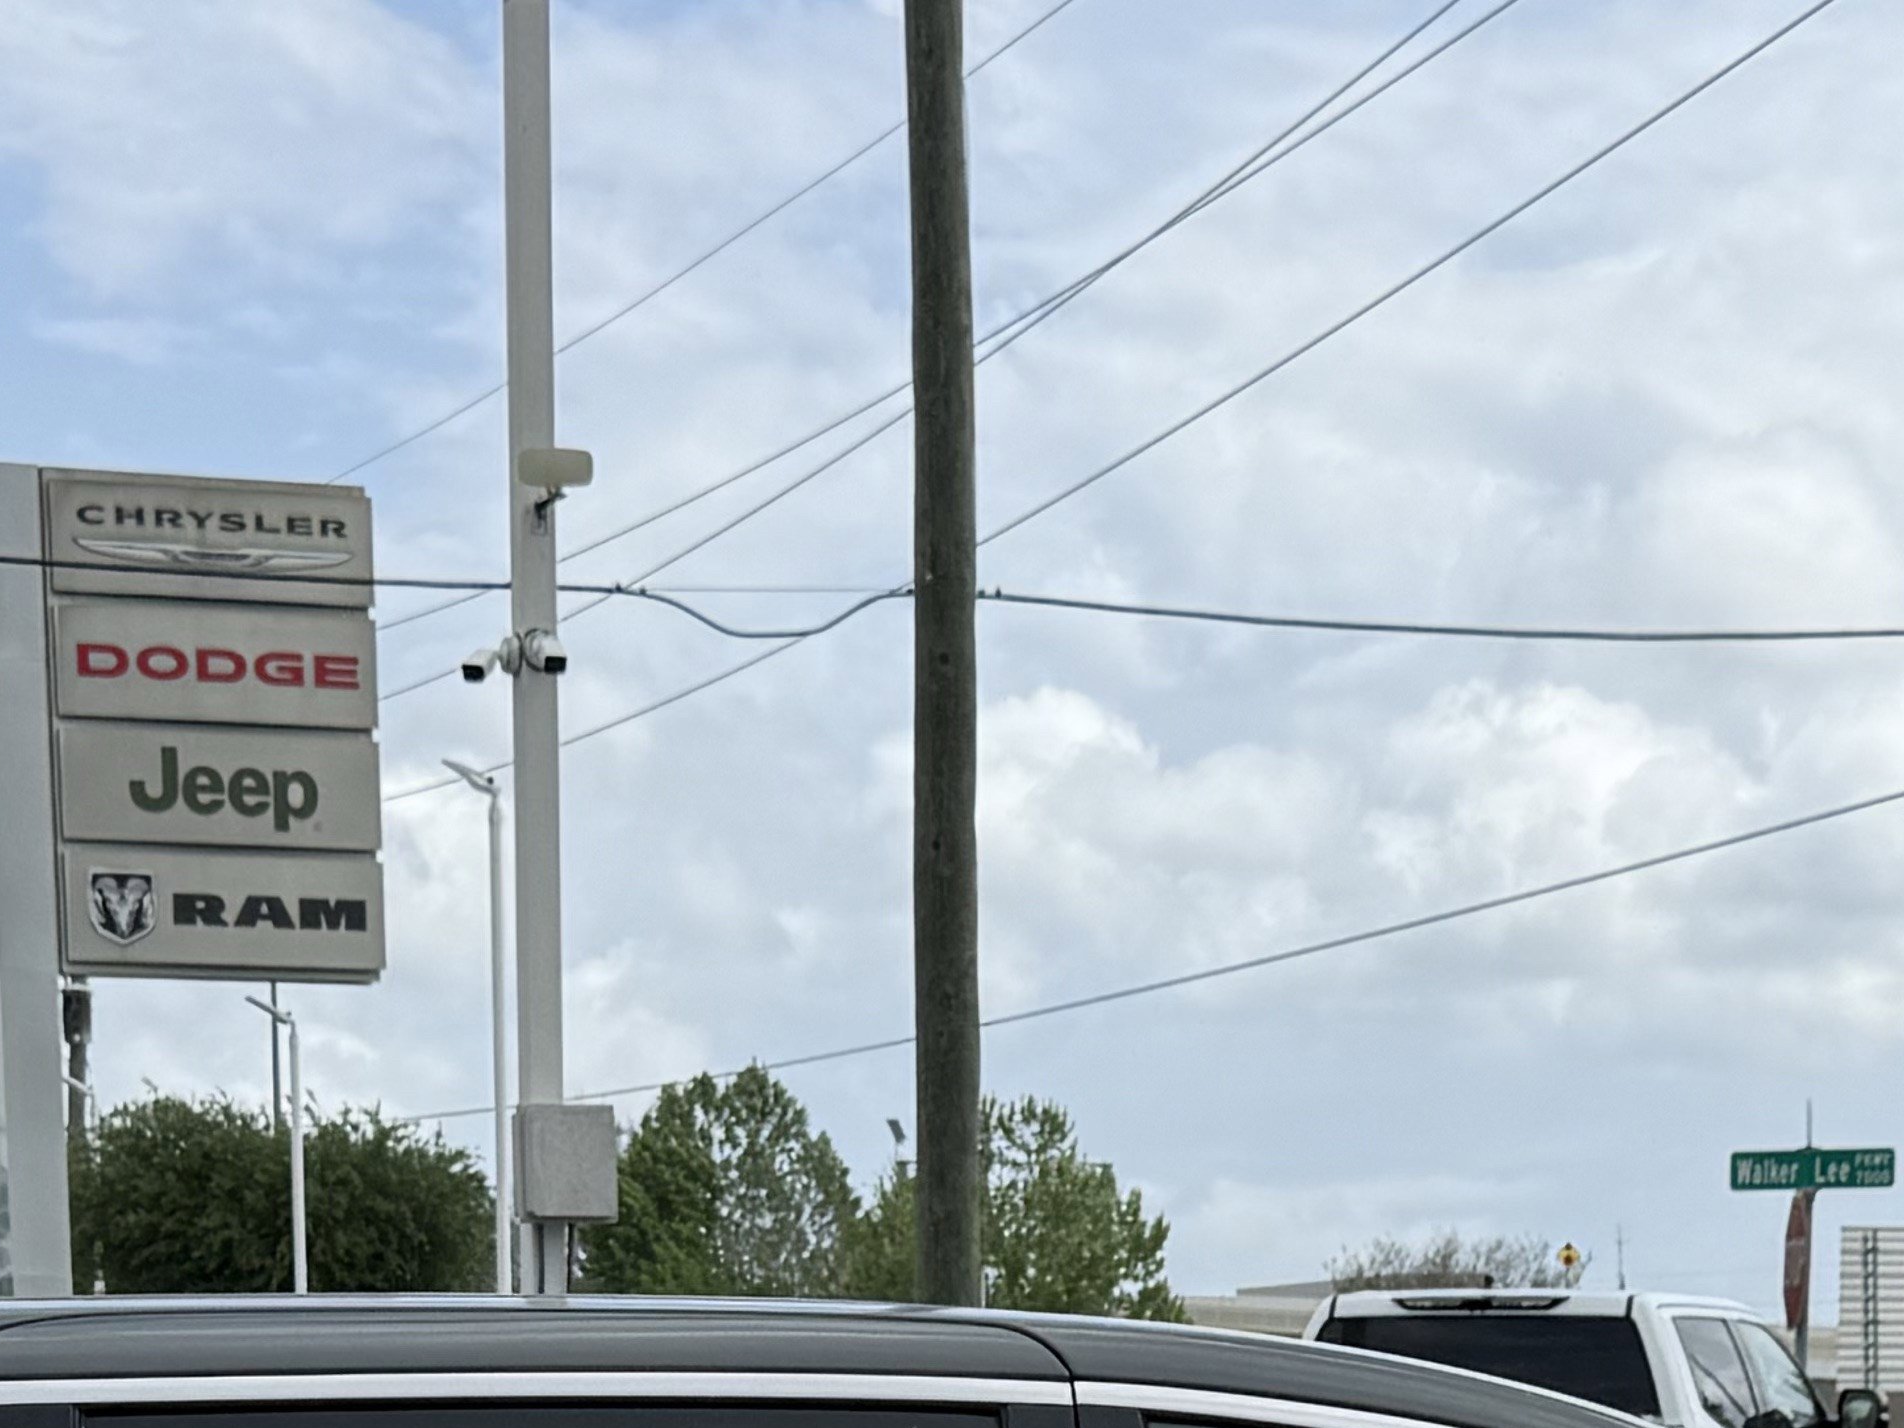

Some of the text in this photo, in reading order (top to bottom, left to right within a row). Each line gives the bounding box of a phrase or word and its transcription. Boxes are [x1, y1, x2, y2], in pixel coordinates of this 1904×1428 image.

[75, 504, 348, 538] CHRYSLER
[76, 643, 360, 690] DODGE
[129, 746, 319, 833] Jeep
[172, 893, 367, 932] RAM
[1736, 1155, 1851, 1186] Walker Lee
